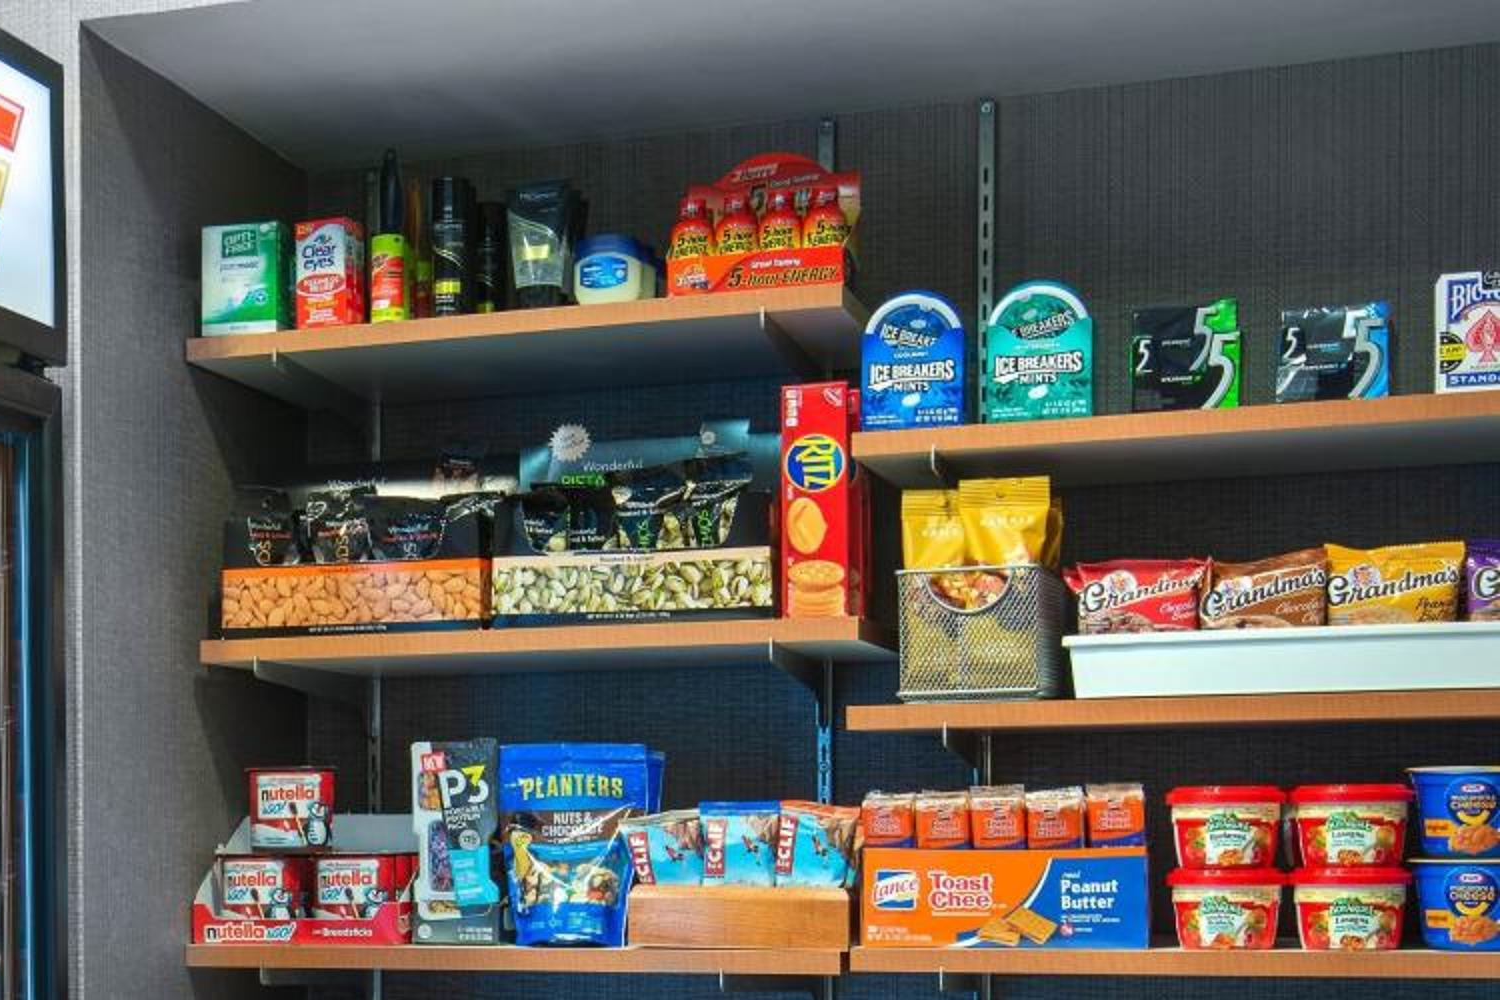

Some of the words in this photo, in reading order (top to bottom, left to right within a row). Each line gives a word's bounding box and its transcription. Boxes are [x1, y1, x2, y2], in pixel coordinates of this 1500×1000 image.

[302, 245, 336, 259] Clear
[304, 257, 334, 271] eyes
[869, 363, 891, 385] ICE
[891, 359, 955, 381] BREAKERS
[996, 356, 1018, 377] ICE
[1018, 351, 1083, 373] BREAKERS
[583, 459, 644, 473] Wonderful
[796, 437, 837, 489] RITZ
[1201, 566, 1326, 619] Grandma's
[1327, 564, 1461, 607] Grandma's
[261, 784, 316, 801] nutella
[438, 765, 490, 808] P3
[520, 774, 624, 800] PLANTERS
[708, 821, 725, 862] CLIF
[778, 816, 797, 858] CLIF
[227, 871, 277, 887] nutella
[321, 871, 373, 886] nutella
[929, 872, 994, 891] Toast
[1061, 879, 1118, 893] Peanut
[931, 891, 992, 909] Chee
[1061, 895, 1115, 910] Butter
[206, 922, 264, 942] nutella
